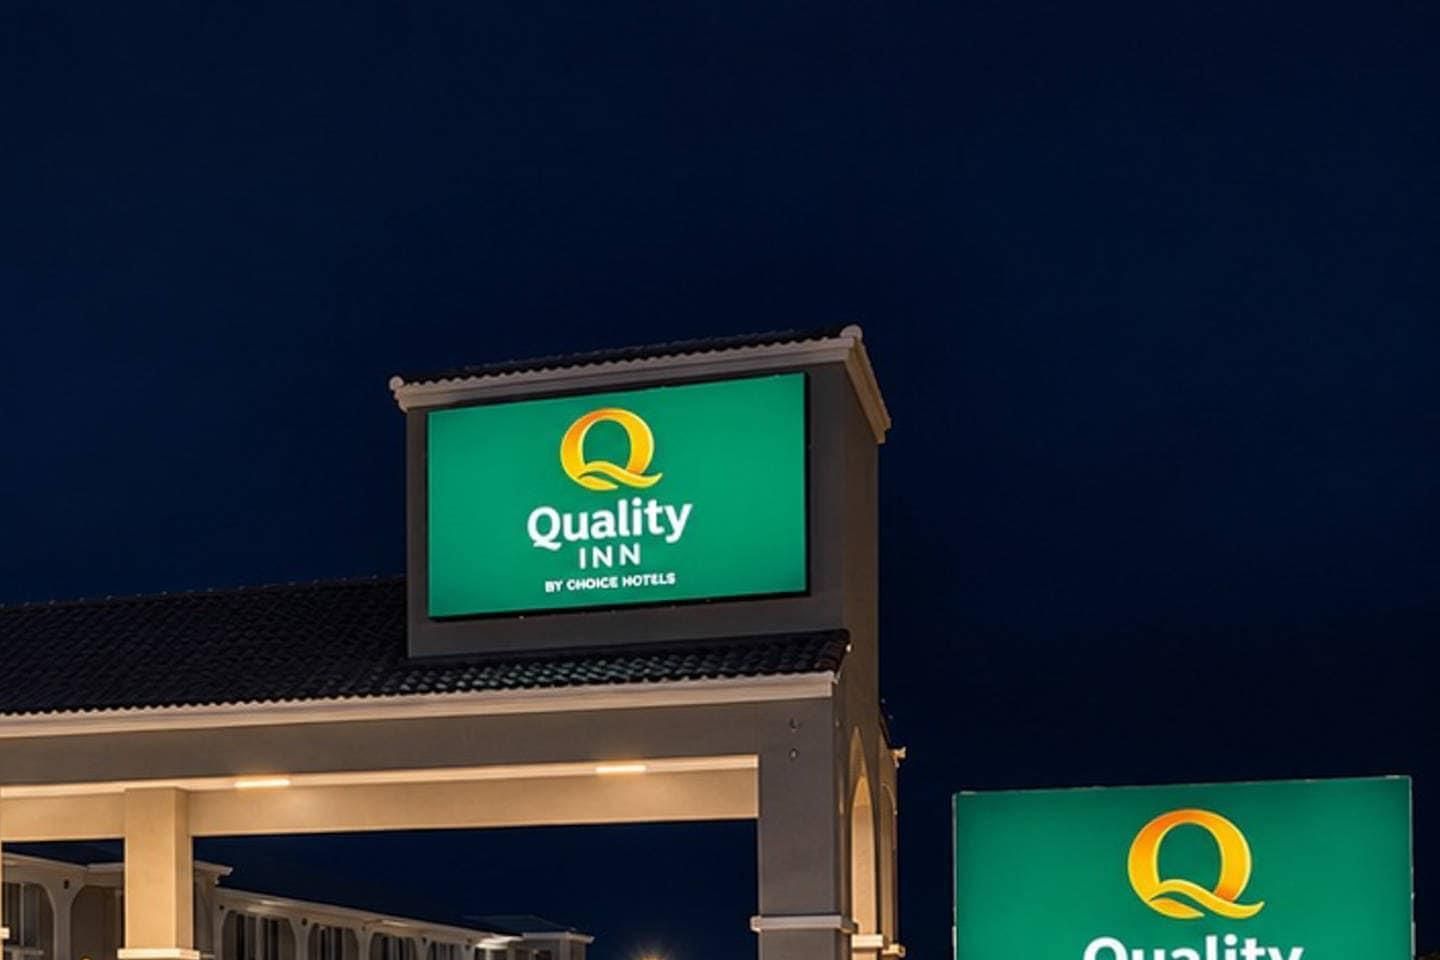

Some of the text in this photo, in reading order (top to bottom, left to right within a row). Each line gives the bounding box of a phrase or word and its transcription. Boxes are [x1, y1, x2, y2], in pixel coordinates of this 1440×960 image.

[559, 407, 663, 491] Q
[527, 497, 692, 551] Quality
[545, 572, 676, 593] BY CHOICE HOTELS
[579, 543, 641, 569] INN
[1127, 808, 1265, 919] Q
